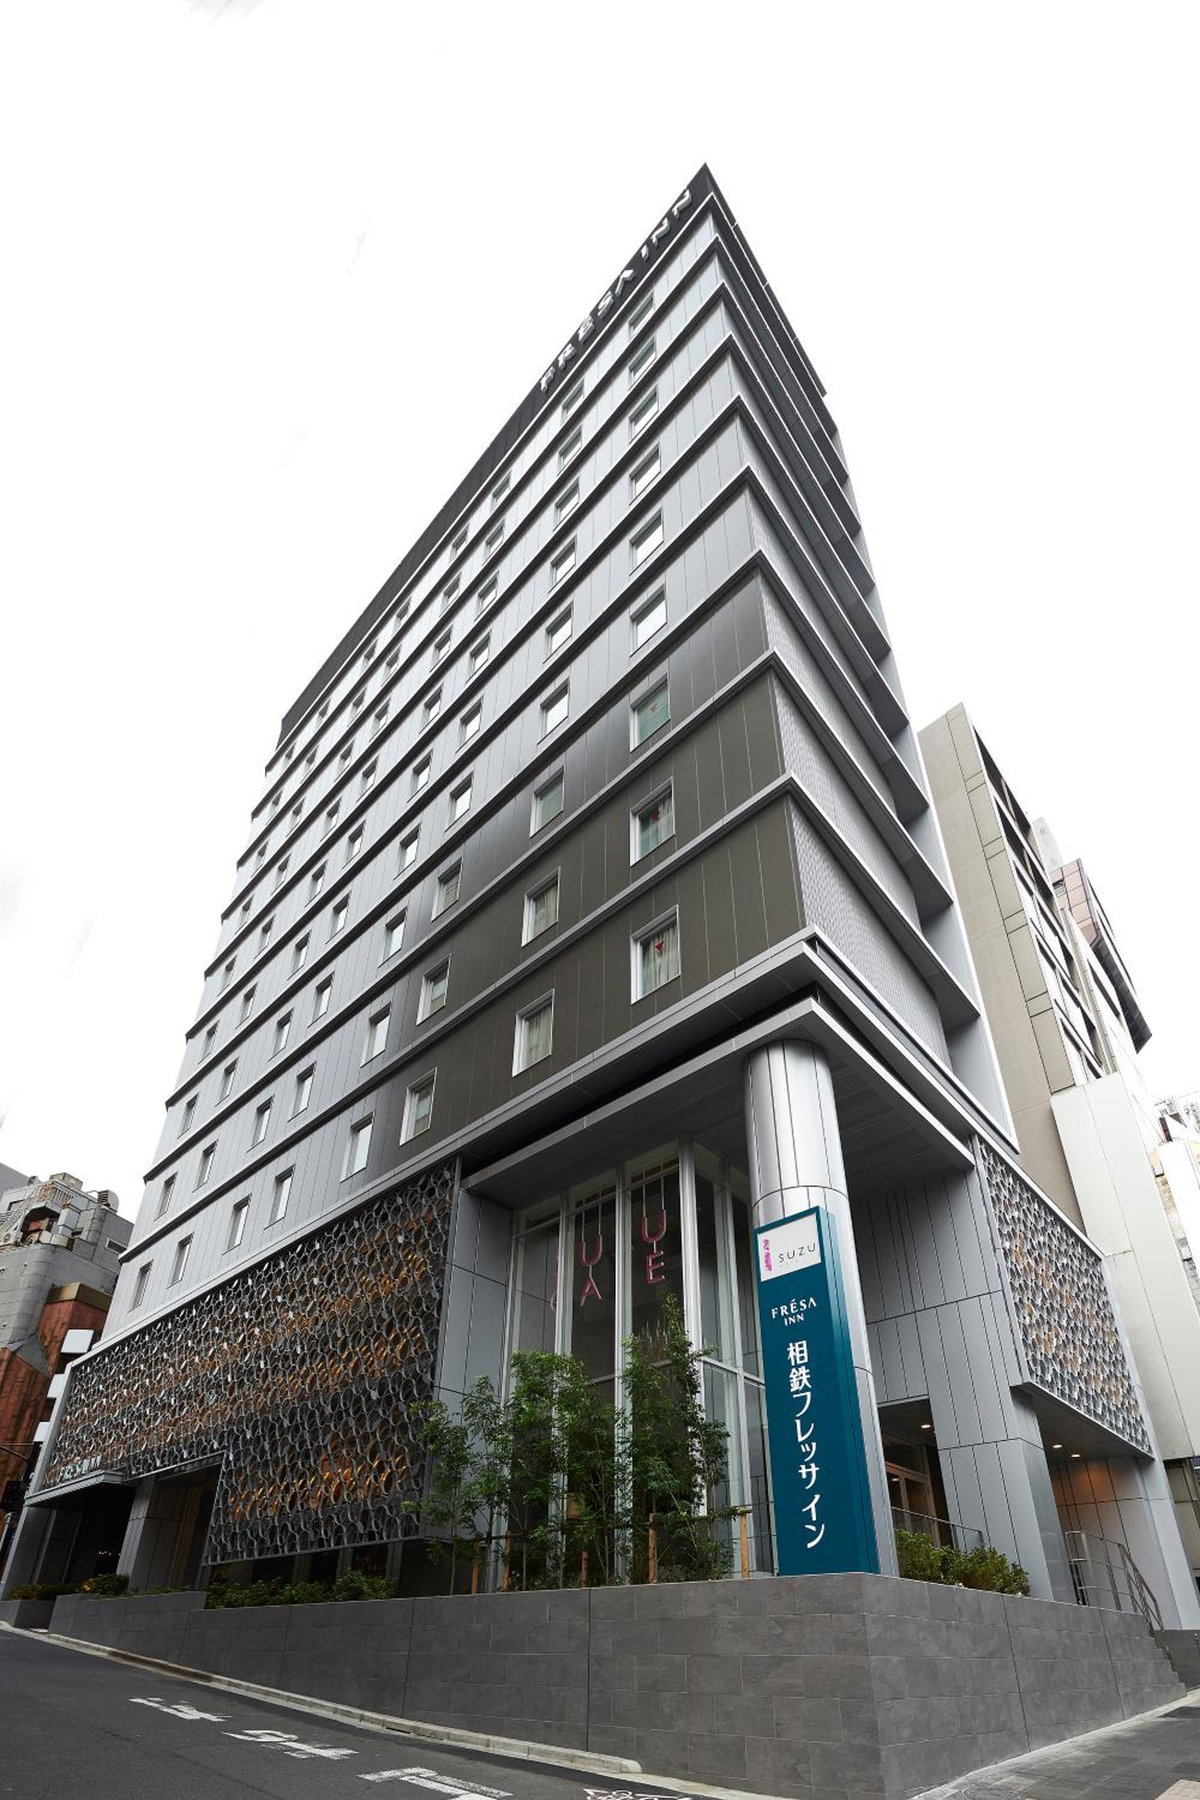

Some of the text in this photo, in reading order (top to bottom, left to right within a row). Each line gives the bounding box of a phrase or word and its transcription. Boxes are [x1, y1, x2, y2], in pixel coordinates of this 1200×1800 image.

[641, 189, 691, 261] INN
[778, 1242, 816, 1263] SUZU
[770, 1297, 817, 1319] FRÉSA
[784, 1313, 805, 1326] INN
[787, 1340, 825, 1549] 相鉄フレッサイン
